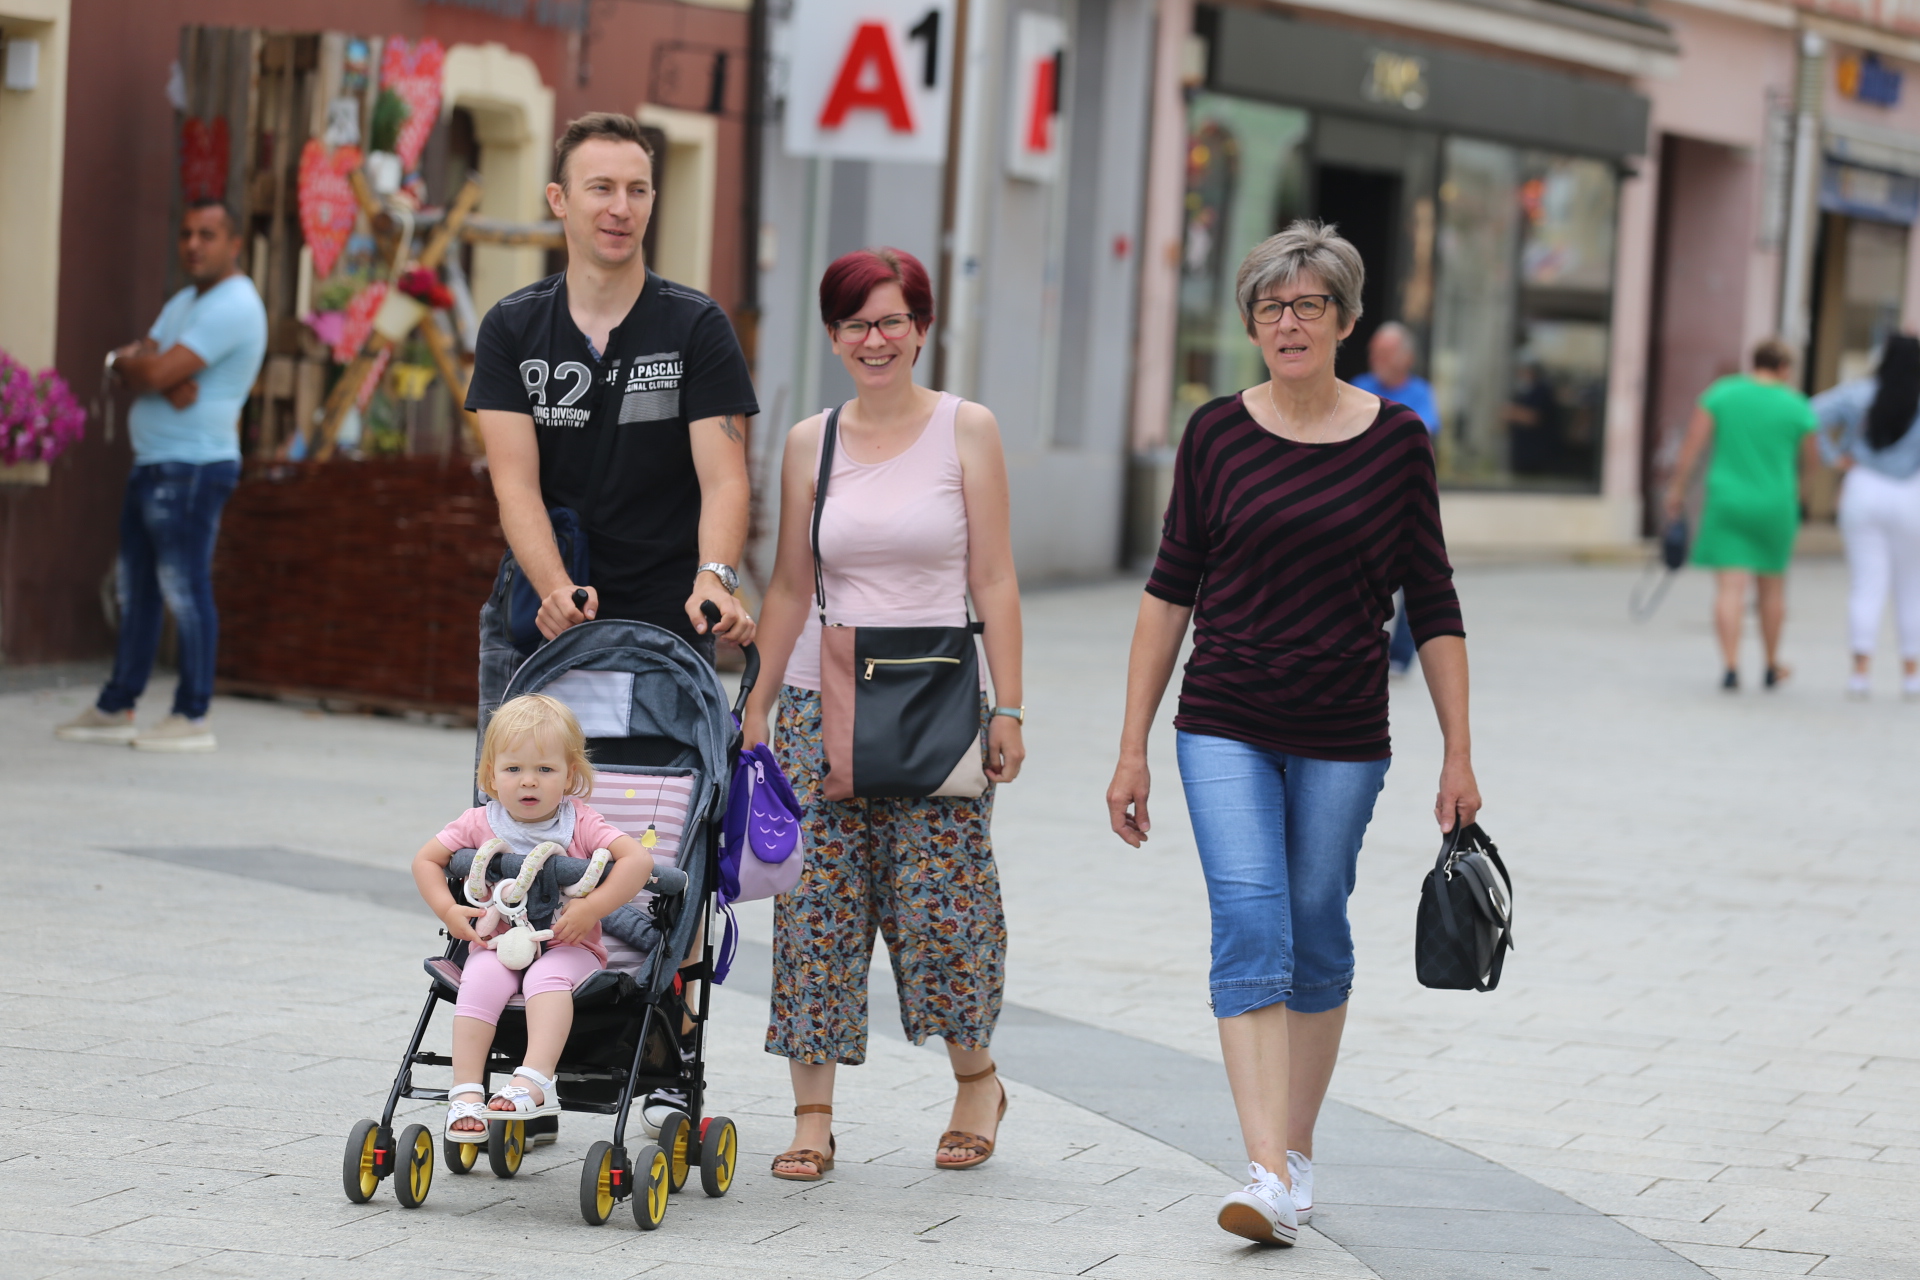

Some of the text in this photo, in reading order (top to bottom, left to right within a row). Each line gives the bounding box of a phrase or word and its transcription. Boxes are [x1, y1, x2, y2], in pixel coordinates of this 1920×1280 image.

[816, 8, 941, 134] A1
[519, 358, 592, 407] 82
[648, 380, 679, 390] CLOTHES
[551, 406, 591, 422] DIVISION
